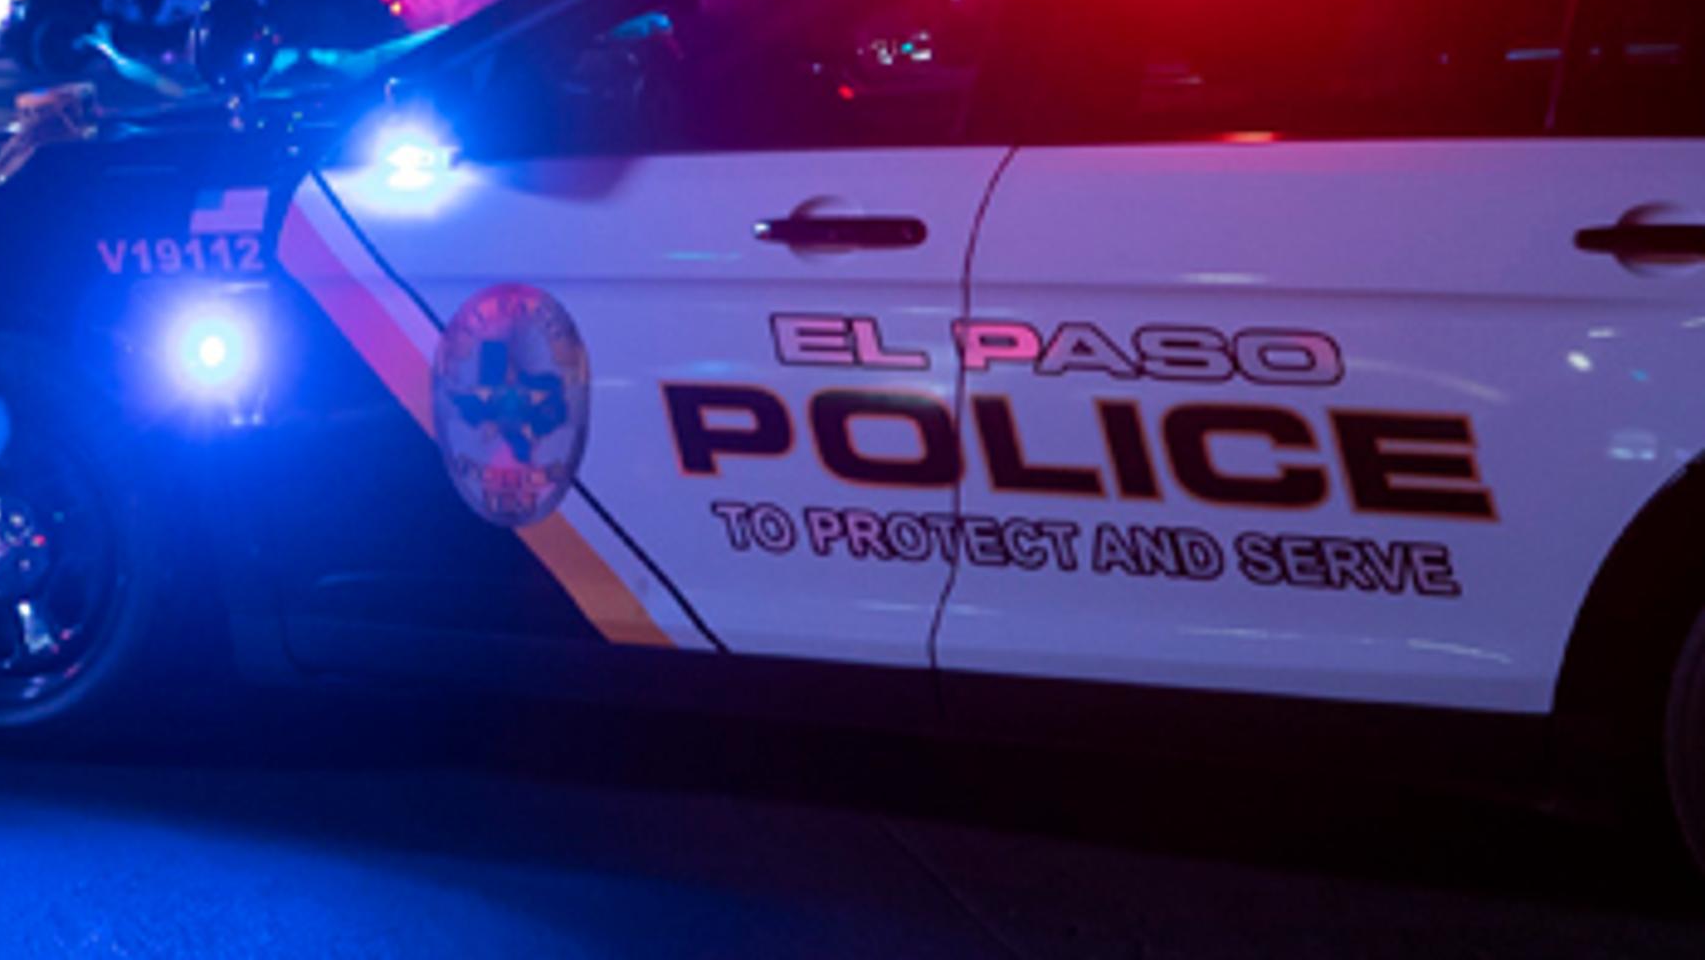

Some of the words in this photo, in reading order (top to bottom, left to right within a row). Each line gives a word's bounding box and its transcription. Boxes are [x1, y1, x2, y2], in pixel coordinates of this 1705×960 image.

[97, 237, 265, 275] V19112
[771, 313, 930, 371] EL
[952, 320, 1345, 386] PASO
[660, 381, 1501, 522] POLICE
[712, 501, 794, 553] TO
[805, 508, 1078, 571] PROTECT
[1092, 522, 1225, 580] AND
[1237, 532, 1462, 596] SERVE
